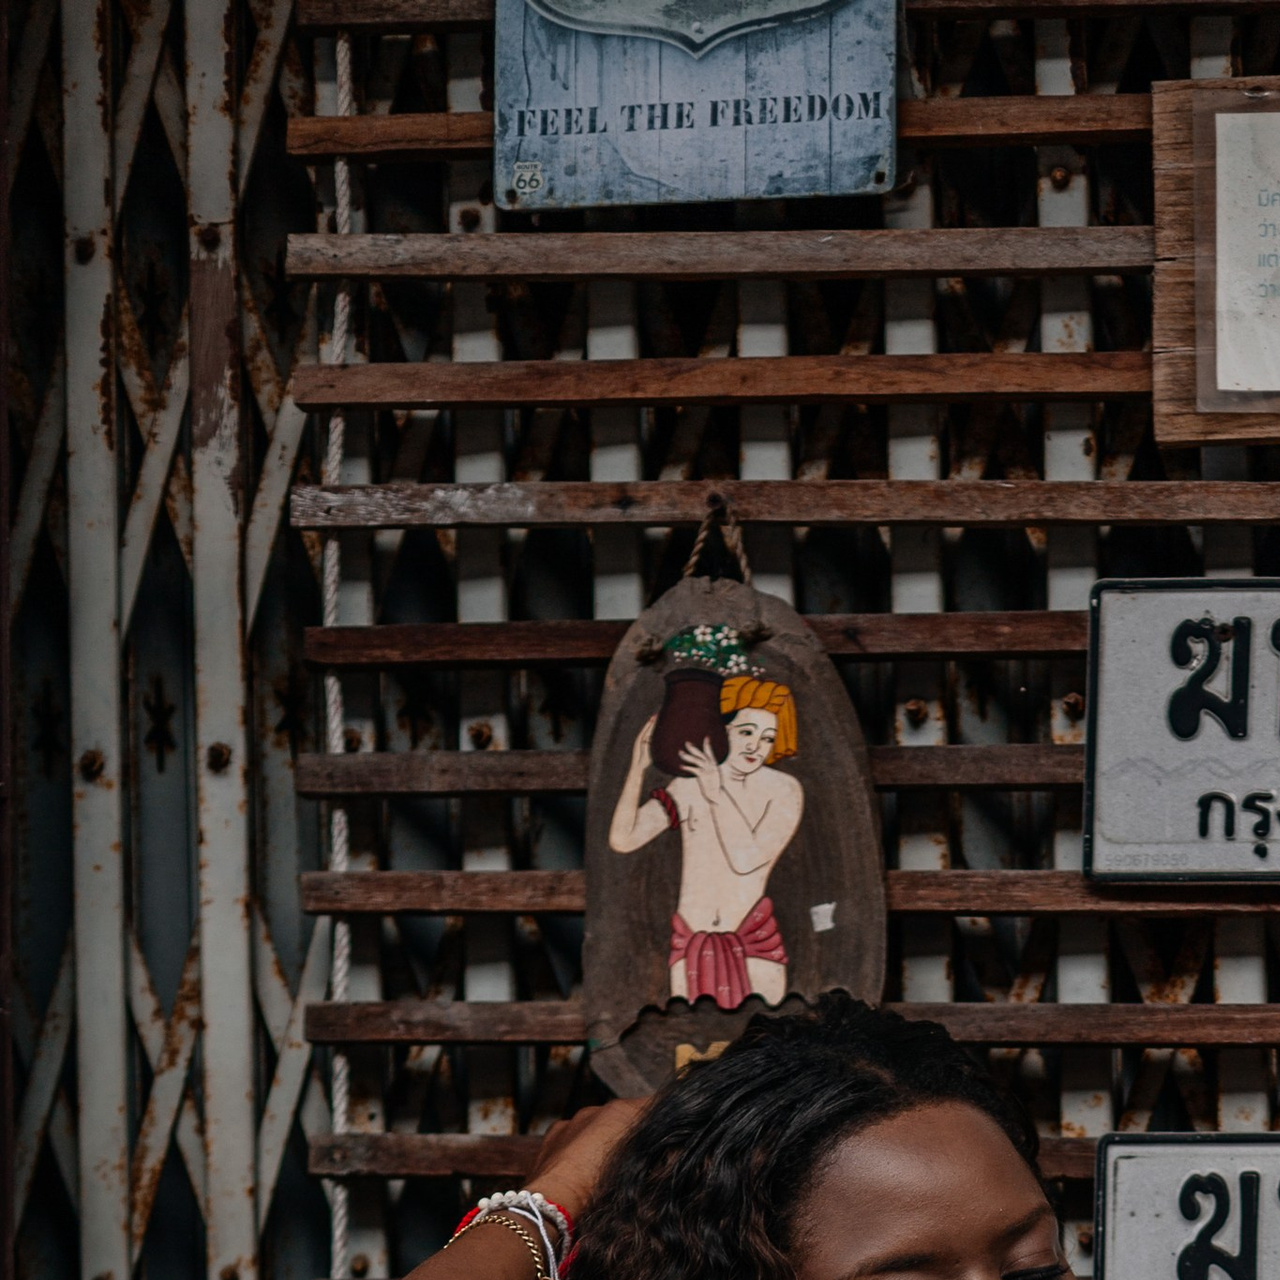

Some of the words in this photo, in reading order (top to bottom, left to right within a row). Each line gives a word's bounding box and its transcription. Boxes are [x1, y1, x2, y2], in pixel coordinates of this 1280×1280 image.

[516, 106, 608, 137] FEEL
[620, 101, 696, 132] THE
[708, 91, 882, 128] FREEDOM
[515, 172, 541, 190] 66
